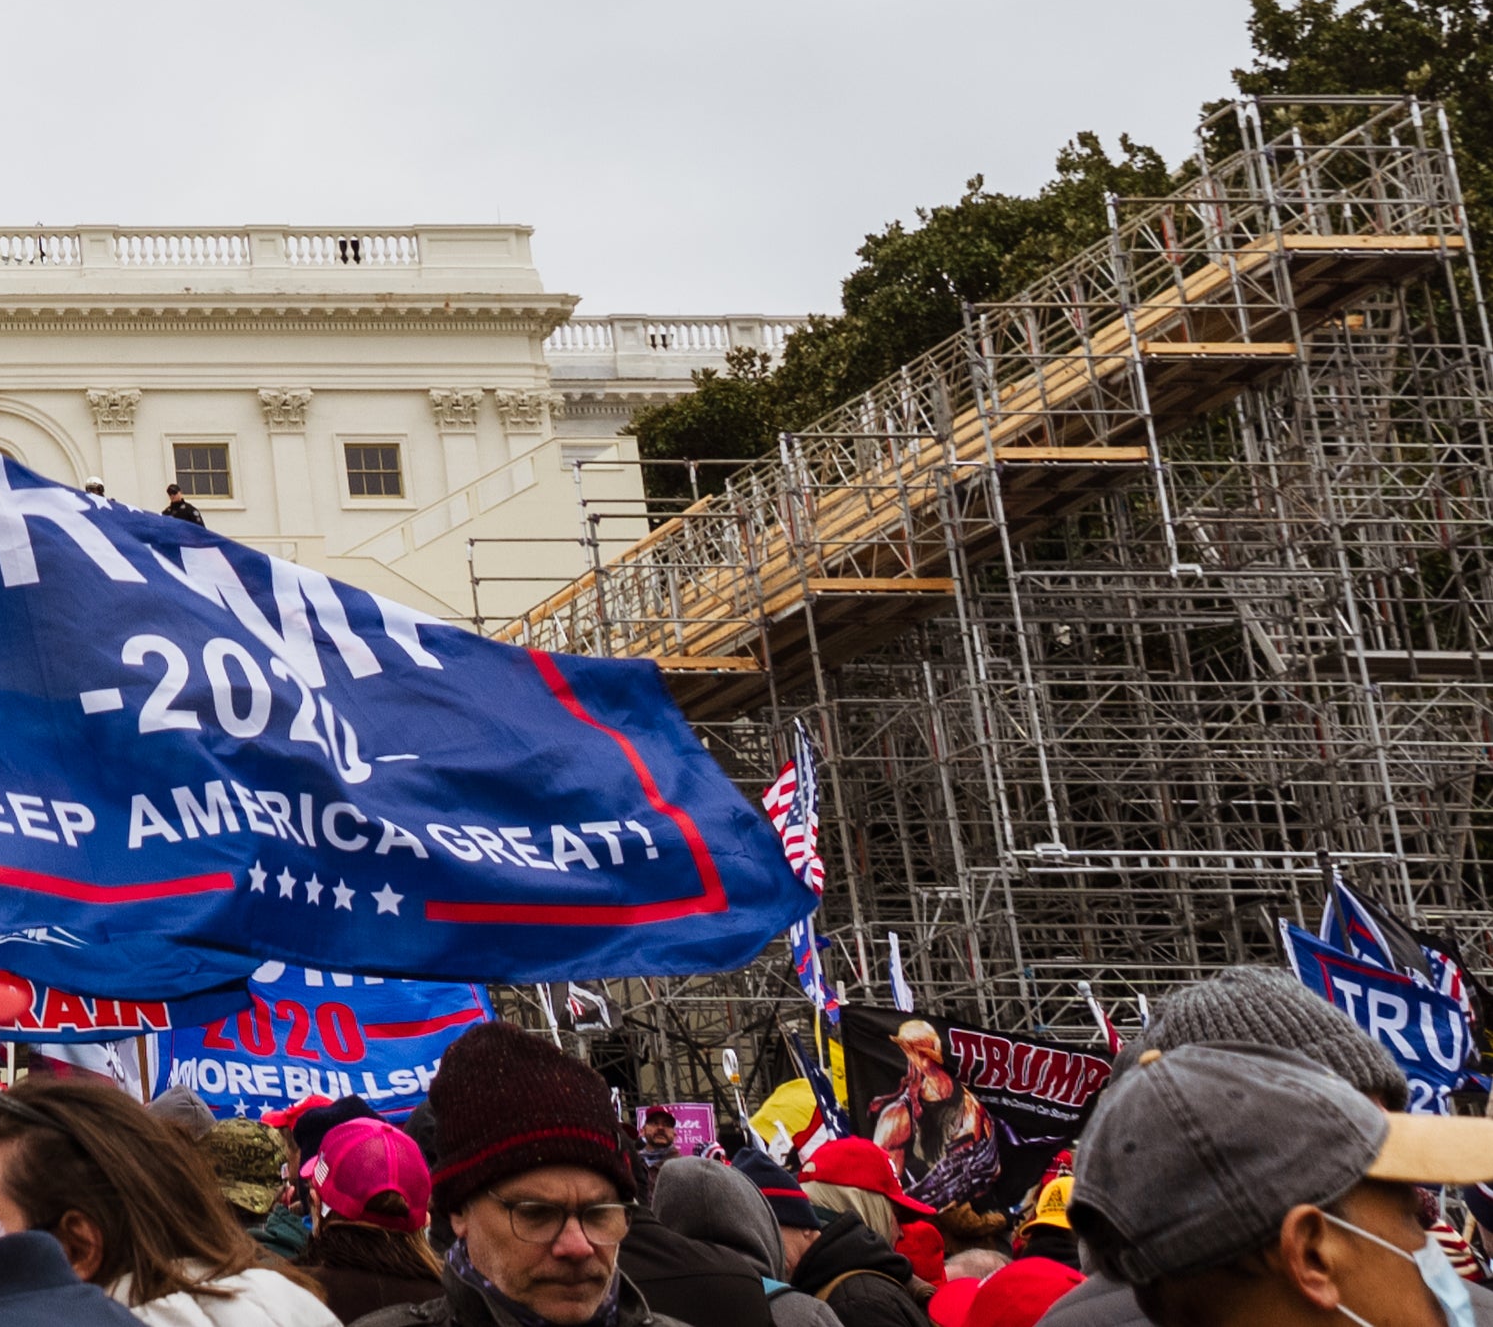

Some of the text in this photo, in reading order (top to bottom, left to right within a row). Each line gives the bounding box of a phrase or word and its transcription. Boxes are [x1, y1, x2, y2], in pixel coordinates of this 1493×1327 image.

[127, 779, 429, 859] AMERICA
[425, 818, 658, 873] GREAT!
[948, 1028, 1112, 1108] TRUMP
